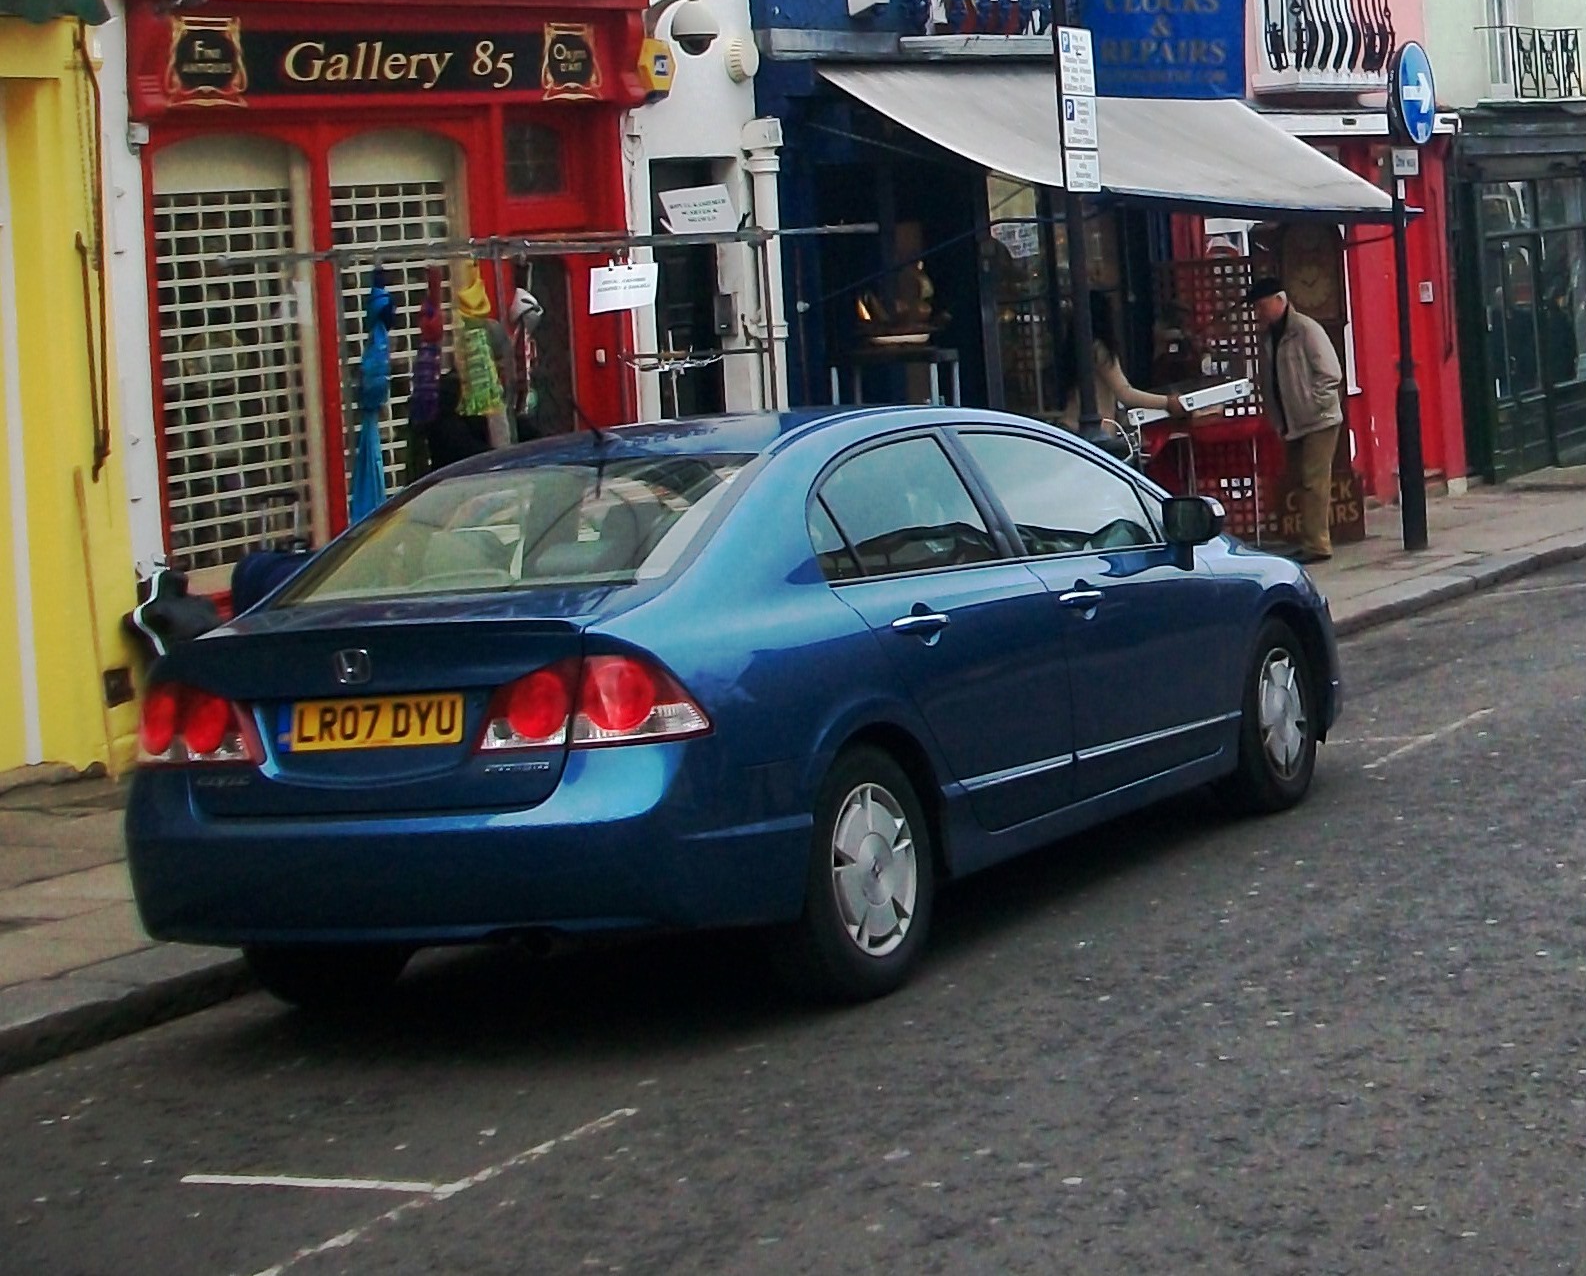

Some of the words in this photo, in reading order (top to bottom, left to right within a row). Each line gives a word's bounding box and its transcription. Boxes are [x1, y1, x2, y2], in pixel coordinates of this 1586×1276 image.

[1152, 15, 1171, 37] &
[284, 40, 453, 90] Gallery
[472, 40, 516, 88] 85
[1102, 38, 1227, 65] REPAIRS
[297, 704, 382, 743] LR07
[391, 700, 456, 738] DYU
